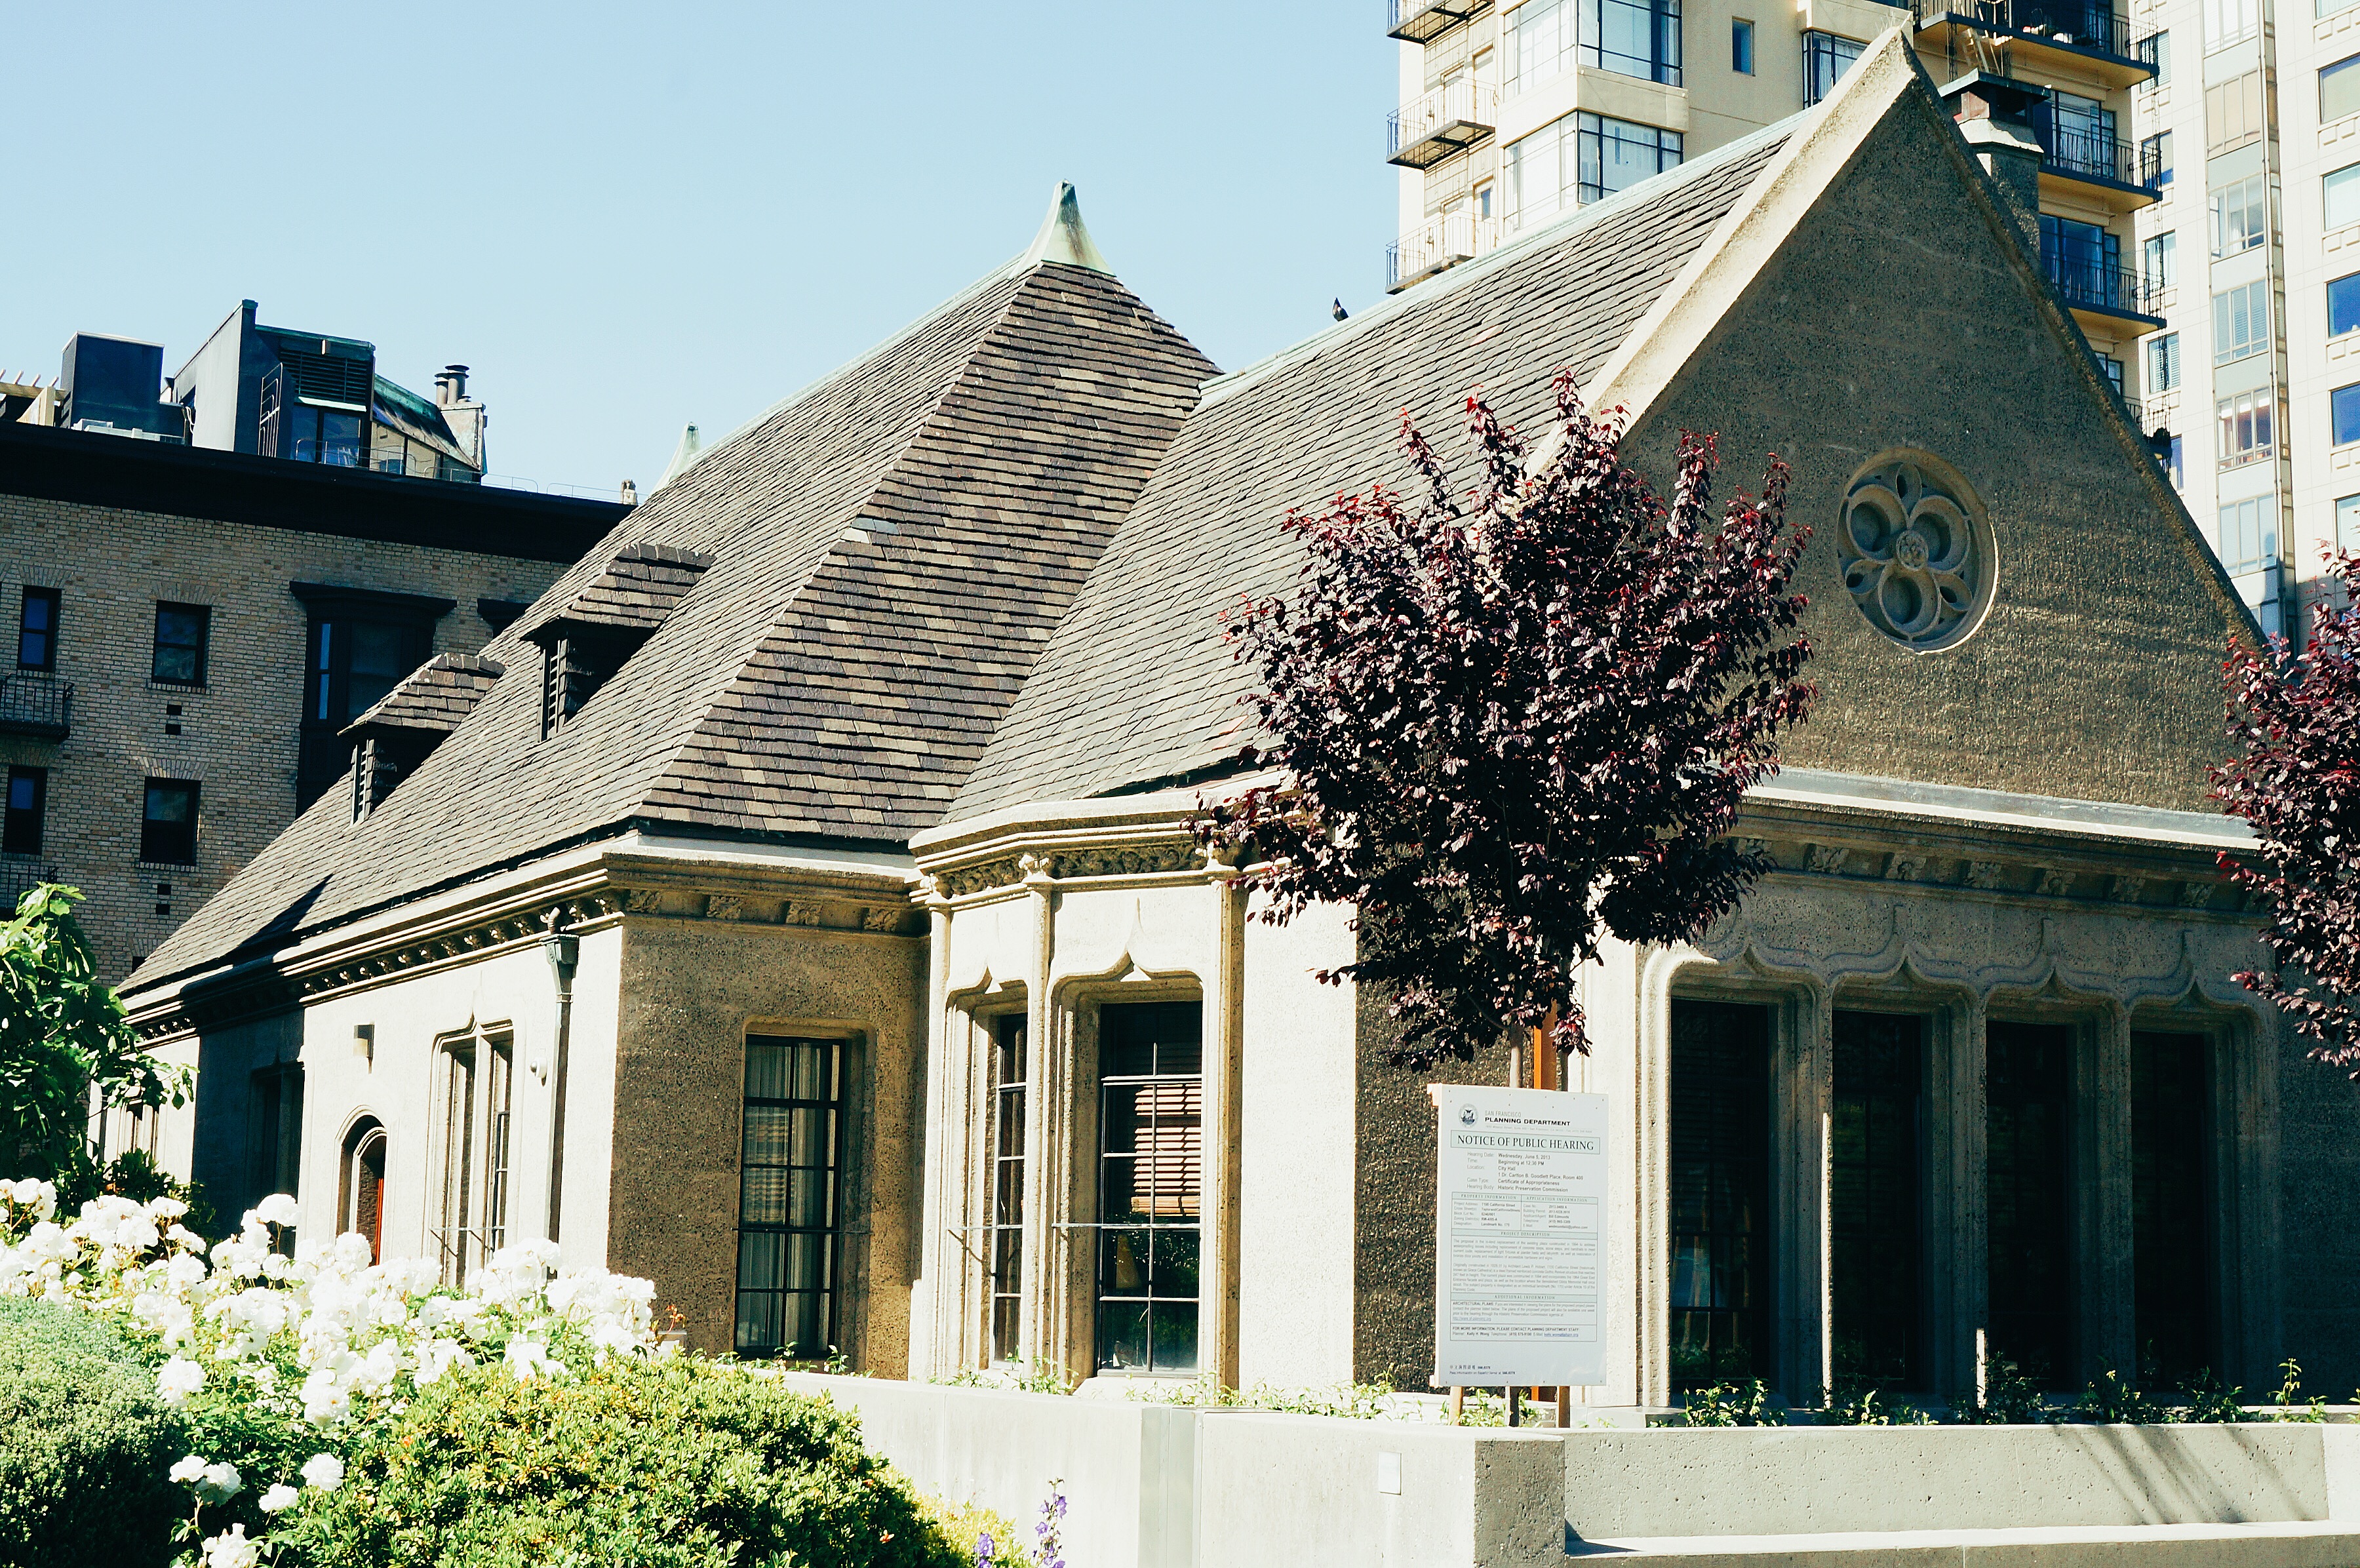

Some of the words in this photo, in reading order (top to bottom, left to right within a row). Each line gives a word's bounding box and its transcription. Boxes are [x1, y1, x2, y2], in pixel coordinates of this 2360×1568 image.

[1457, 1135, 1495, 1146] NOTICE
[1497, 1137, 1510, 1146] OF
[1513, 1137, 1547, 1148] PUBLIC
[1550, 1139, 1594, 1150] HEARING
